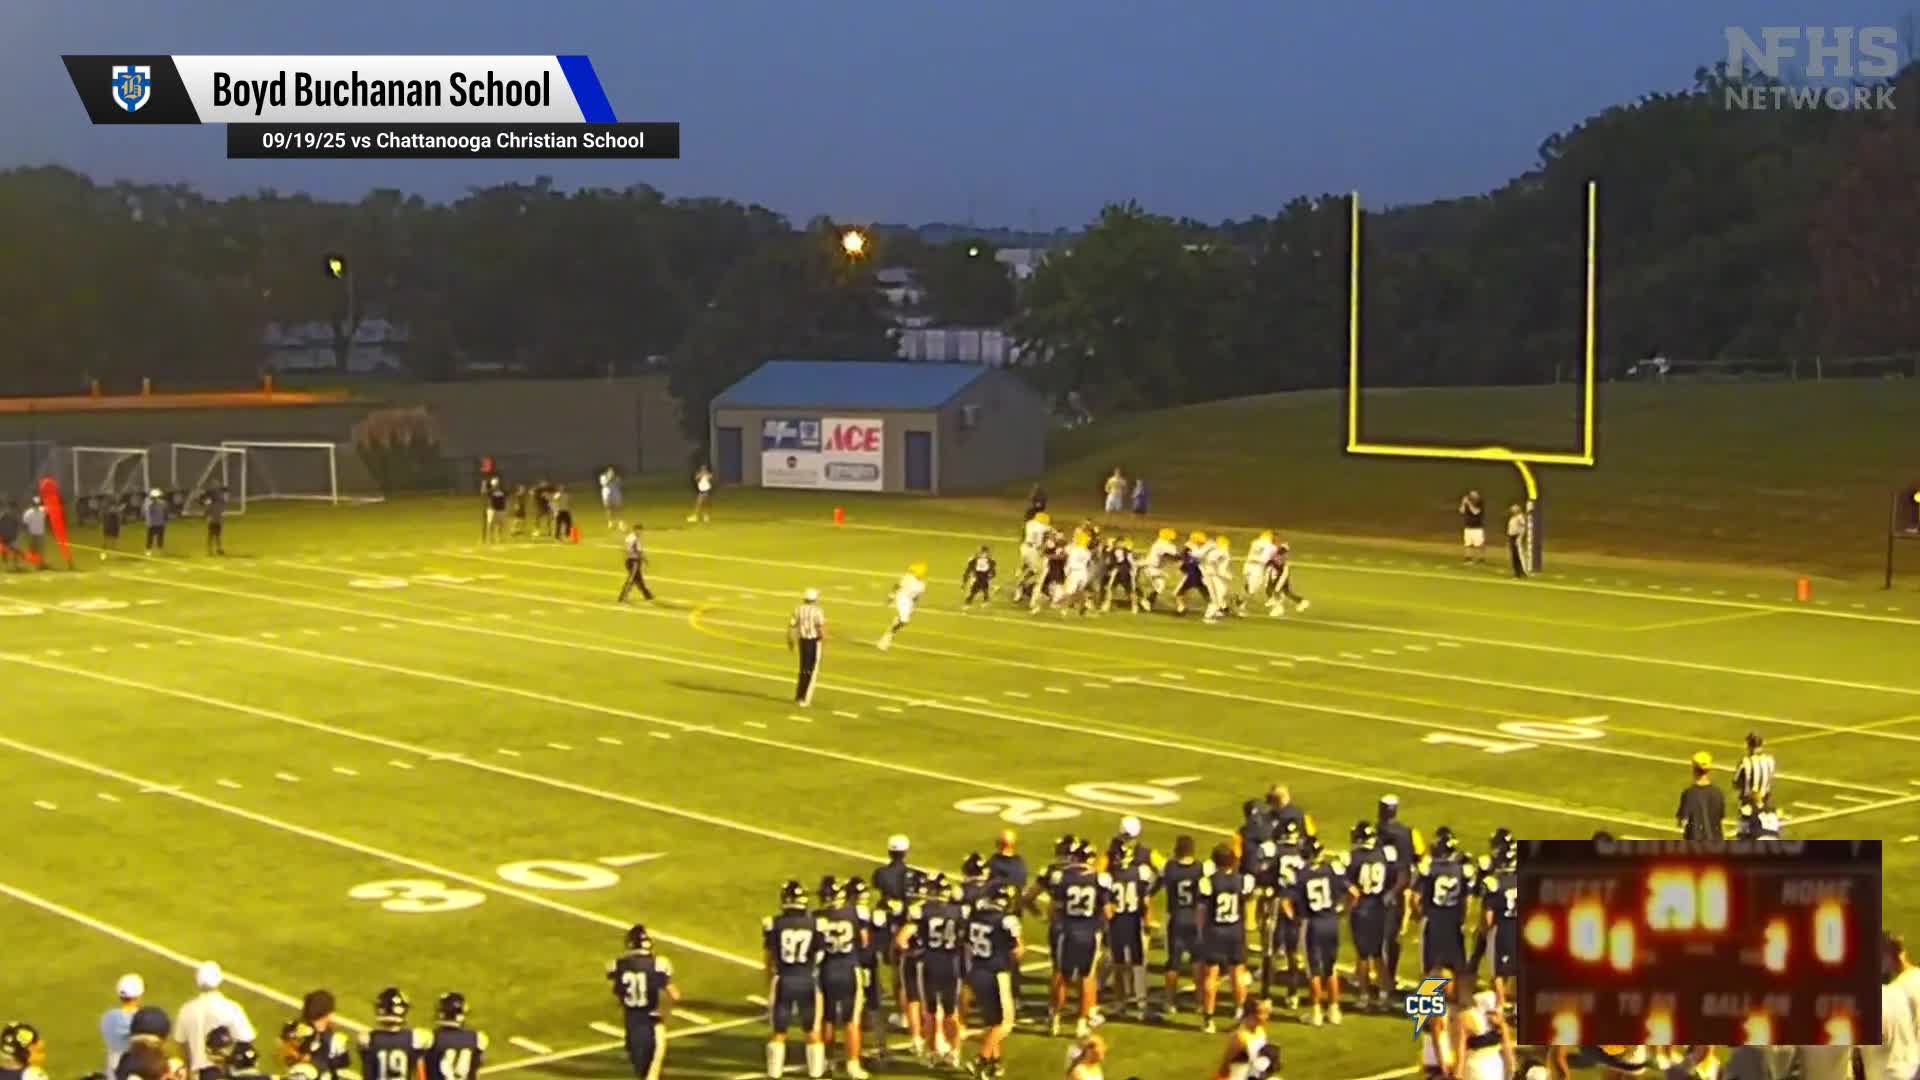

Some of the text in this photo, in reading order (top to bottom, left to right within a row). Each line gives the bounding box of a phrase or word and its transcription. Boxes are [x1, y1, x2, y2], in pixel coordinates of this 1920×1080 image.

[824, 424, 881, 452] ACE
[954, 782, 1180, 825] 20
[347, 860, 619, 912] 30
[1177, 879, 1193, 905] 5
[1305, 876, 1332, 912] 51
[1358, 861, 1386, 894] 49
[1066, 885, 1097, 918] 23
[1111, 880, 1139, 914] 34
[1215, 892, 1240, 923] 21
[928, 916, 957, 950] 54
[622, 971, 649, 1008] 31
[377, 1050, 409, 1080] 19
